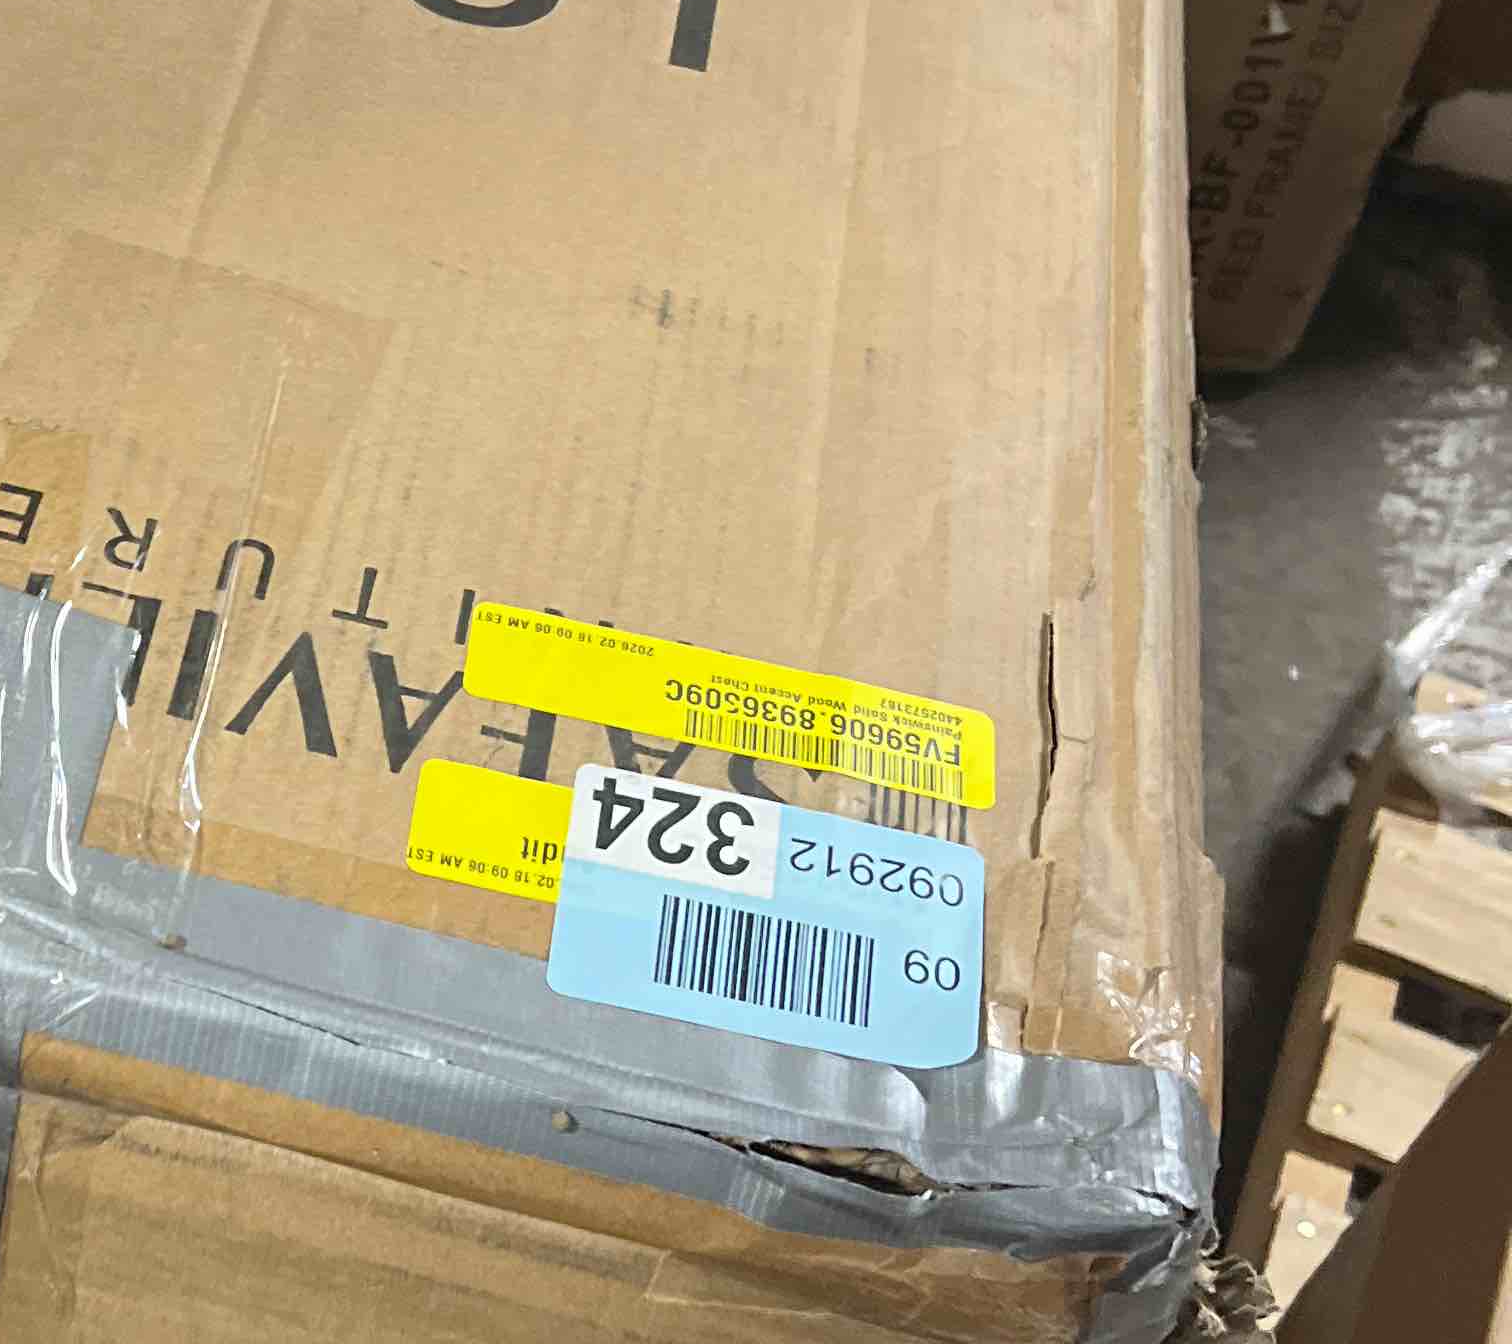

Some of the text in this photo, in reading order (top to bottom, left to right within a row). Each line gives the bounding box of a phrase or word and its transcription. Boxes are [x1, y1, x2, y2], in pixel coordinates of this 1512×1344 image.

[439, 850, 464, 869] AM
[520, 835, 567, 865] dit
[592, 776, 964, 907] 092912 324
[903, 949, 961, 992] 09
